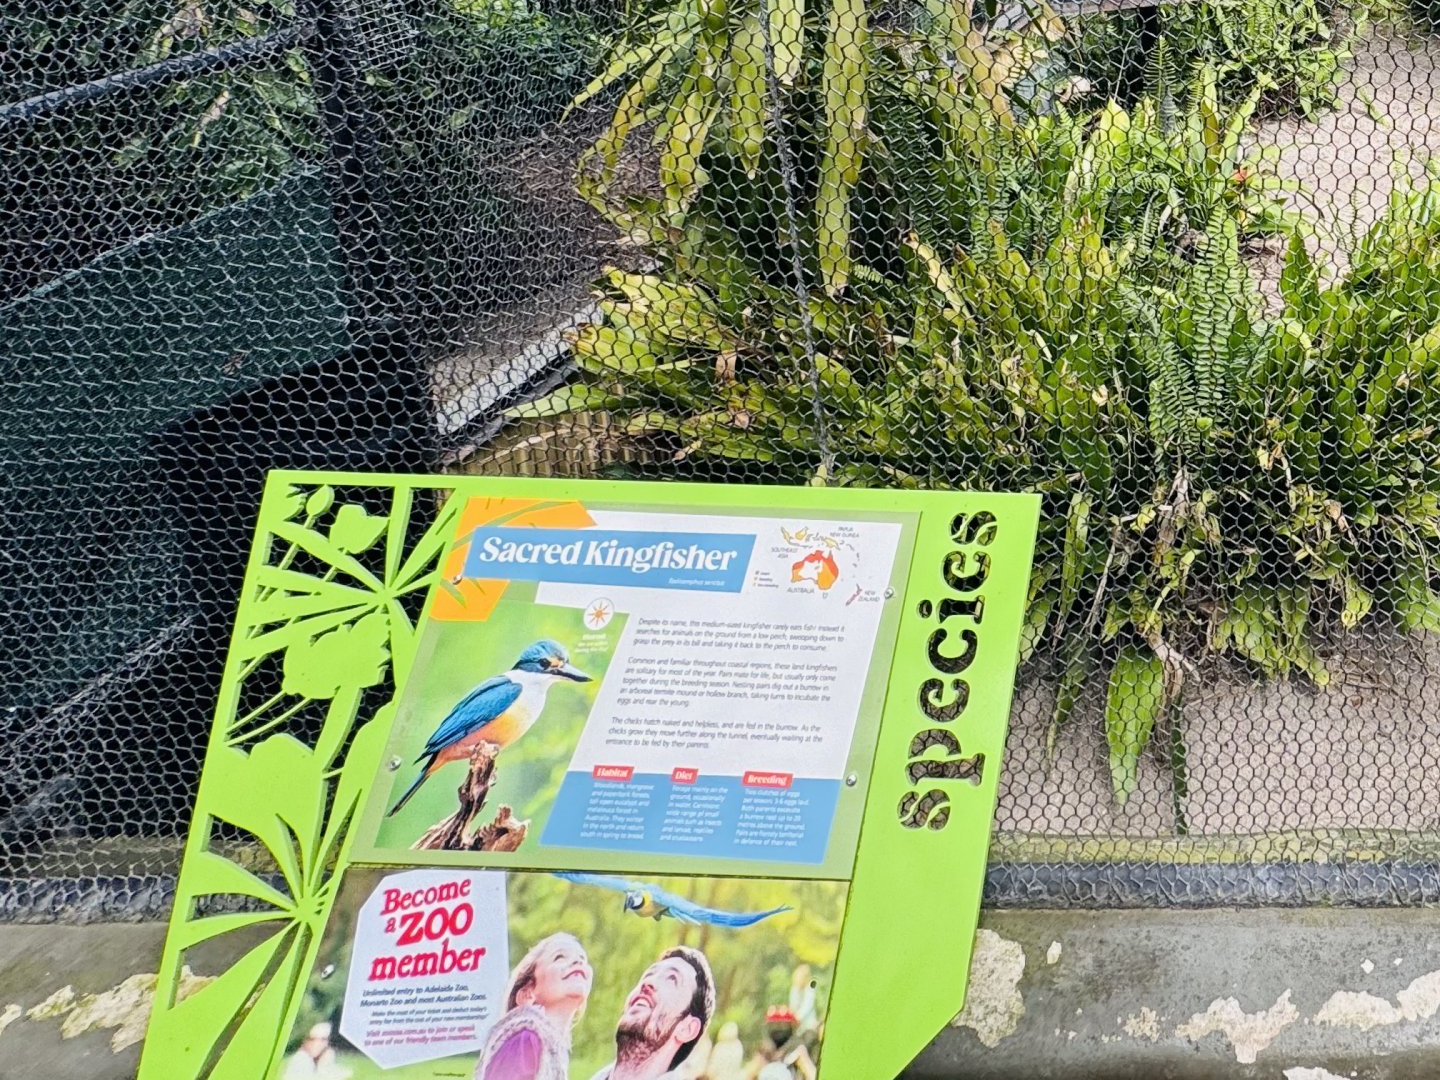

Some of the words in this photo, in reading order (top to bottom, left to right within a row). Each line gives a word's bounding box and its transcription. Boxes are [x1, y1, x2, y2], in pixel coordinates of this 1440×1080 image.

[479, 536, 583, 565] Sacred
[584, 540, 737, 573] Kingfisher
[897, 510, 998, 831] species
[675, 771, 693, 780] Diet
[747, 775, 788, 786] Breeding
[380, 878, 471, 916] Become
[384, 917, 396, 934] a
[396, 902, 474, 947] ZOO
[368, 938, 486, 981] member
